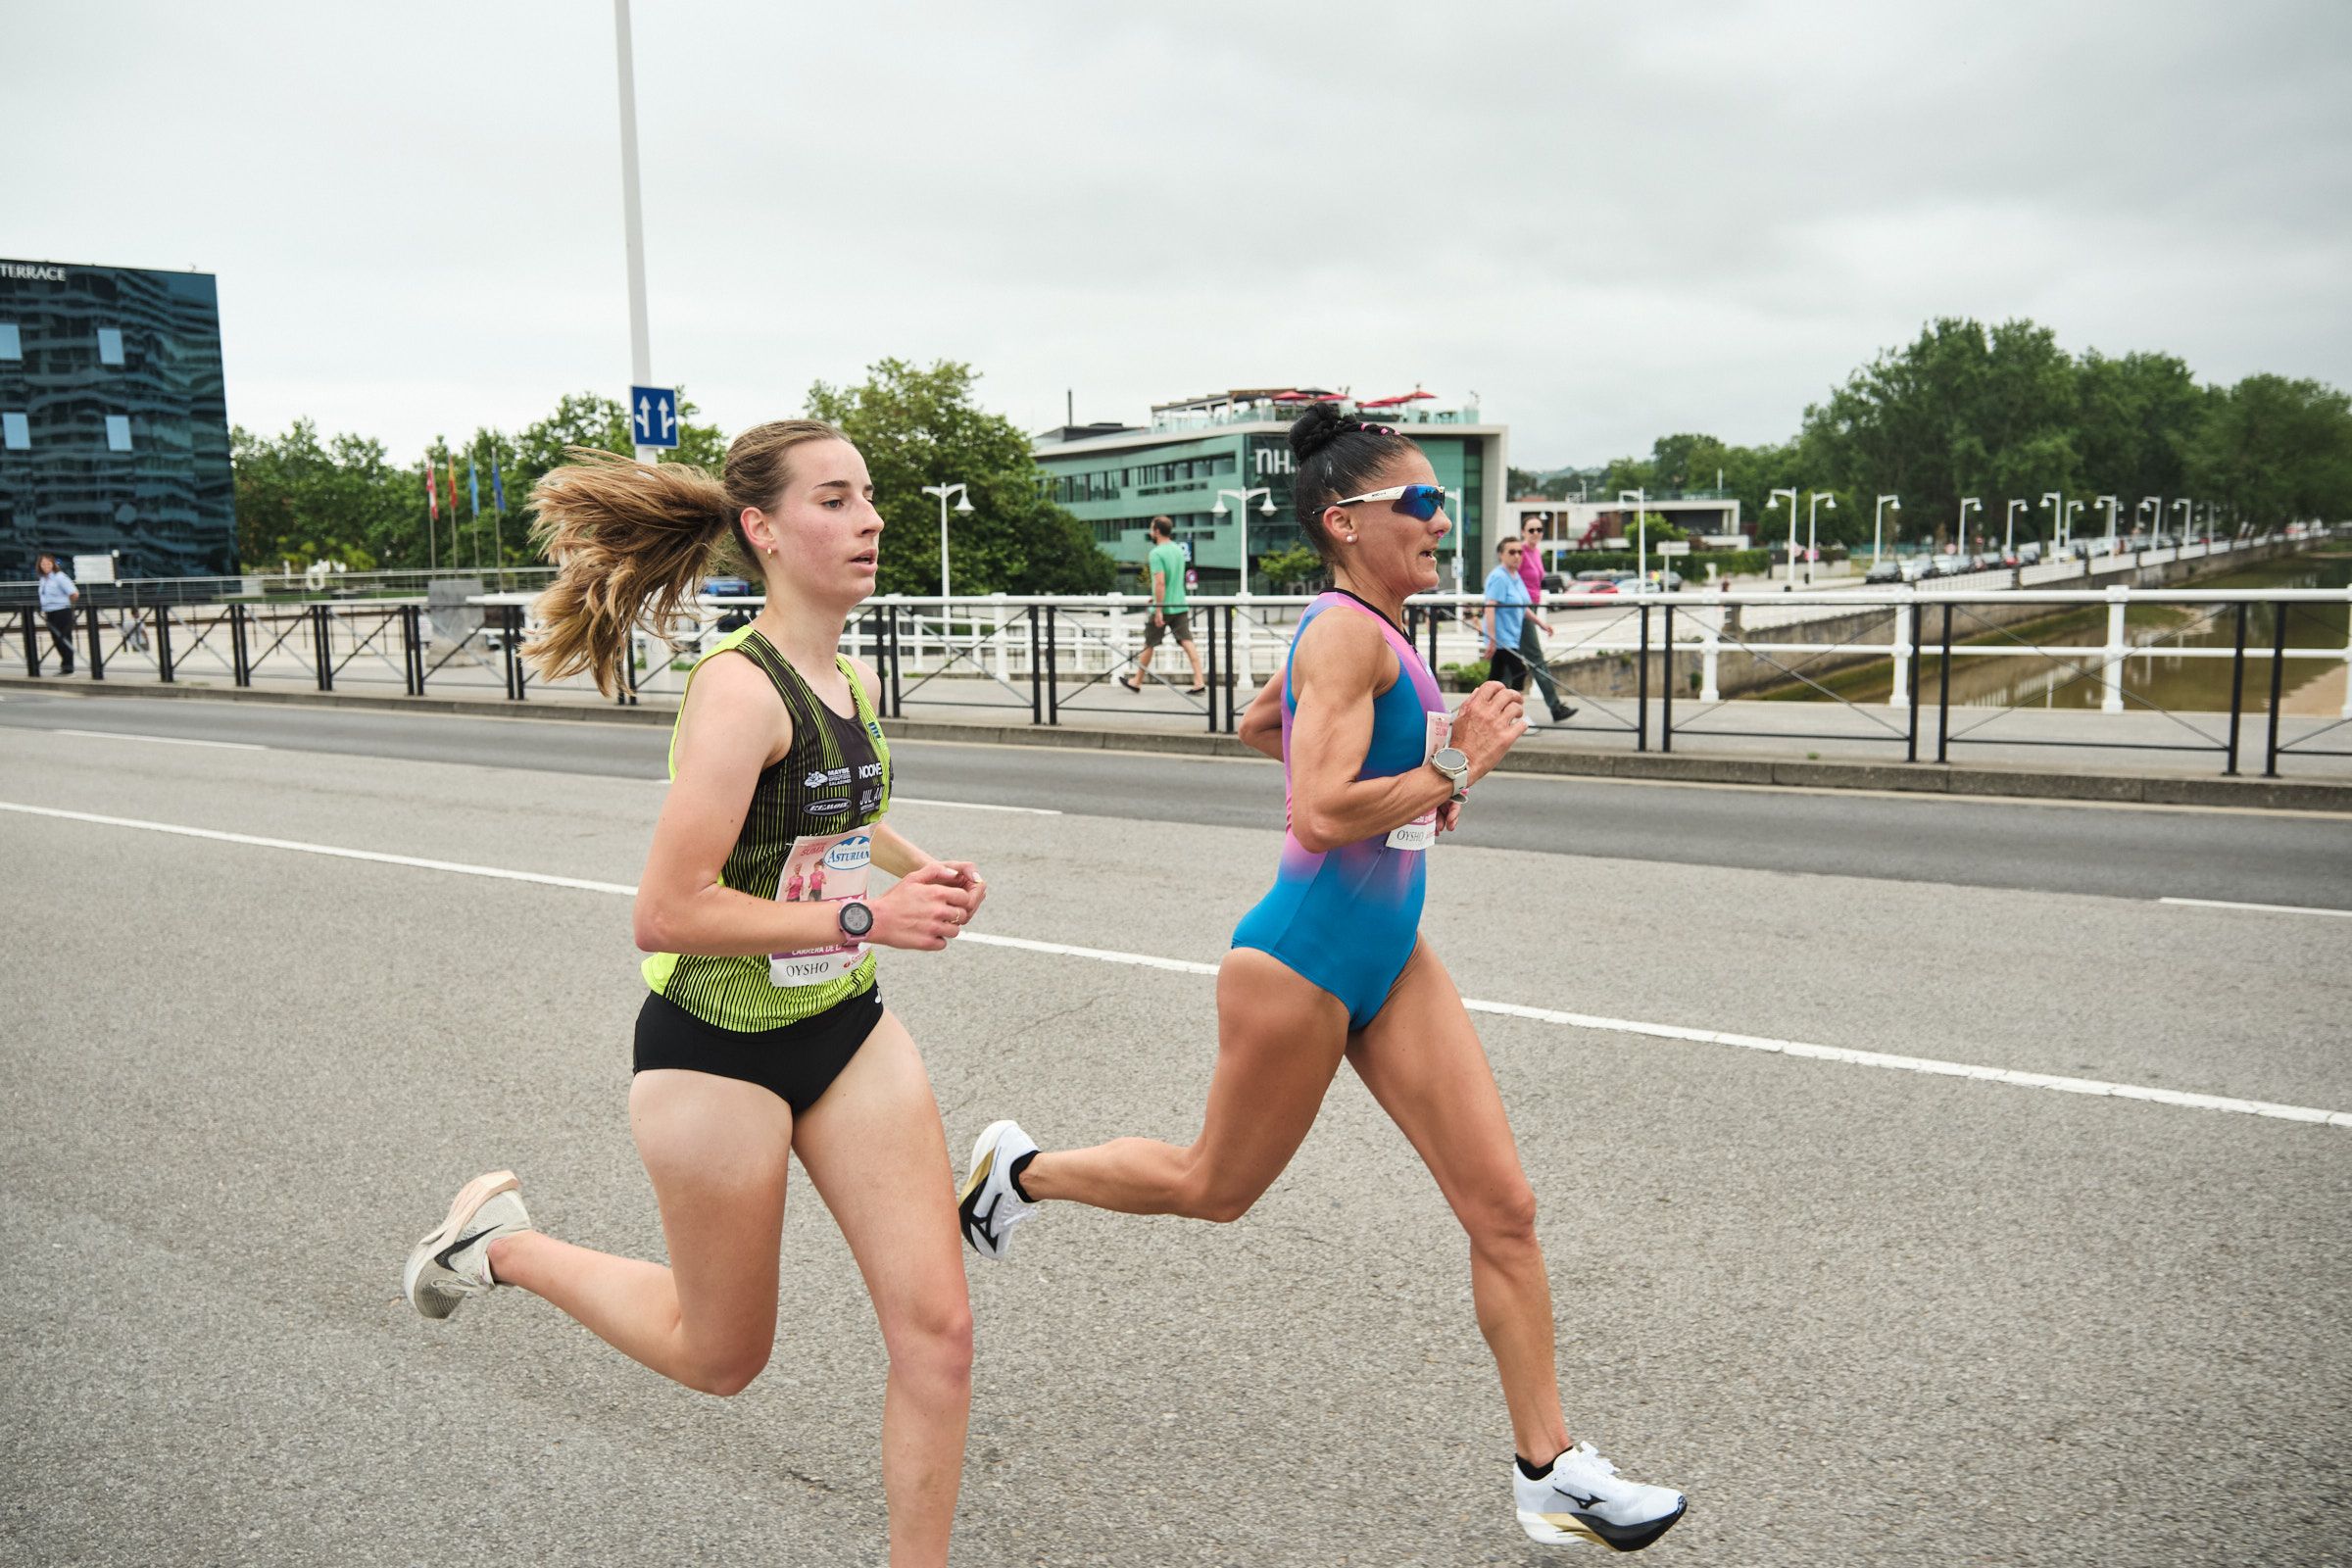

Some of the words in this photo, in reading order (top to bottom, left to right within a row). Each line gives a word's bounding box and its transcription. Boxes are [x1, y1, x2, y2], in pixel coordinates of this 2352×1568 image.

[0, 264, 67, 281] TERRACE
[1396, 829, 1424, 842] OYSHO
[786, 961, 829, 977] OYSHO
